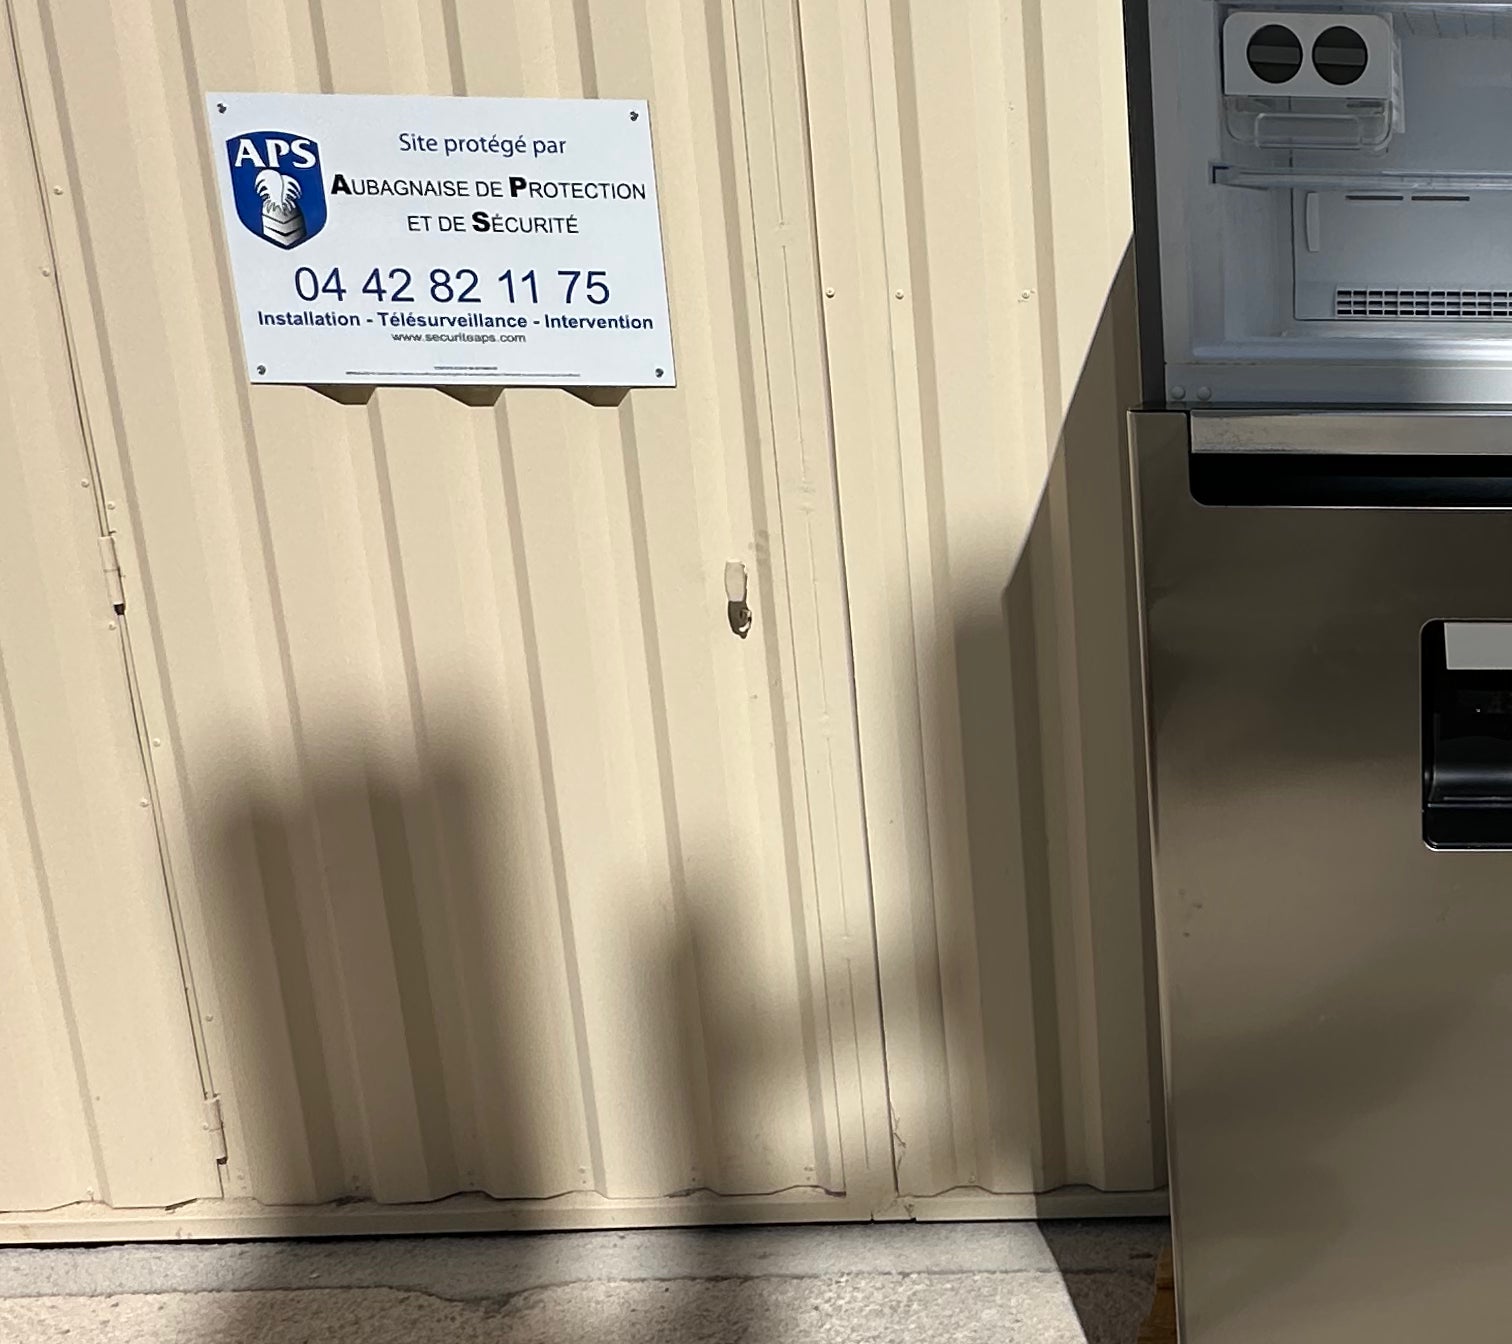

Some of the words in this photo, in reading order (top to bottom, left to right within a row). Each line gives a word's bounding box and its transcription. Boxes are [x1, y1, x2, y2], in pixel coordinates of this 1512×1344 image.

[234, 138, 317, 169] APS
[399, 133, 438, 152] Site
[444, 134, 527, 158] protégé
[533, 139, 567, 158] par
[330, 174, 470, 197] AUBAGNAISE
[475, 181, 504, 197] DE
[508, 176, 646, 200] PROTECTION
[407, 215, 432, 231] ET
[438, 216, 466, 232] DE
[472, 211, 580, 234] SÉCURITÉ
[294, 266, 347, 302] 04
[361, 267, 415, 302] 42
[429, 268, 482, 303] 82
[498, 269, 538, 304] 11
[557, 270, 610, 305] 75
[257, 311, 361, 326] Installation
[376, 312, 528, 328] Télésurveillance
[544, 314, 654, 329] Intervention
[391, 332, 527, 344] www.securiteaps.com
